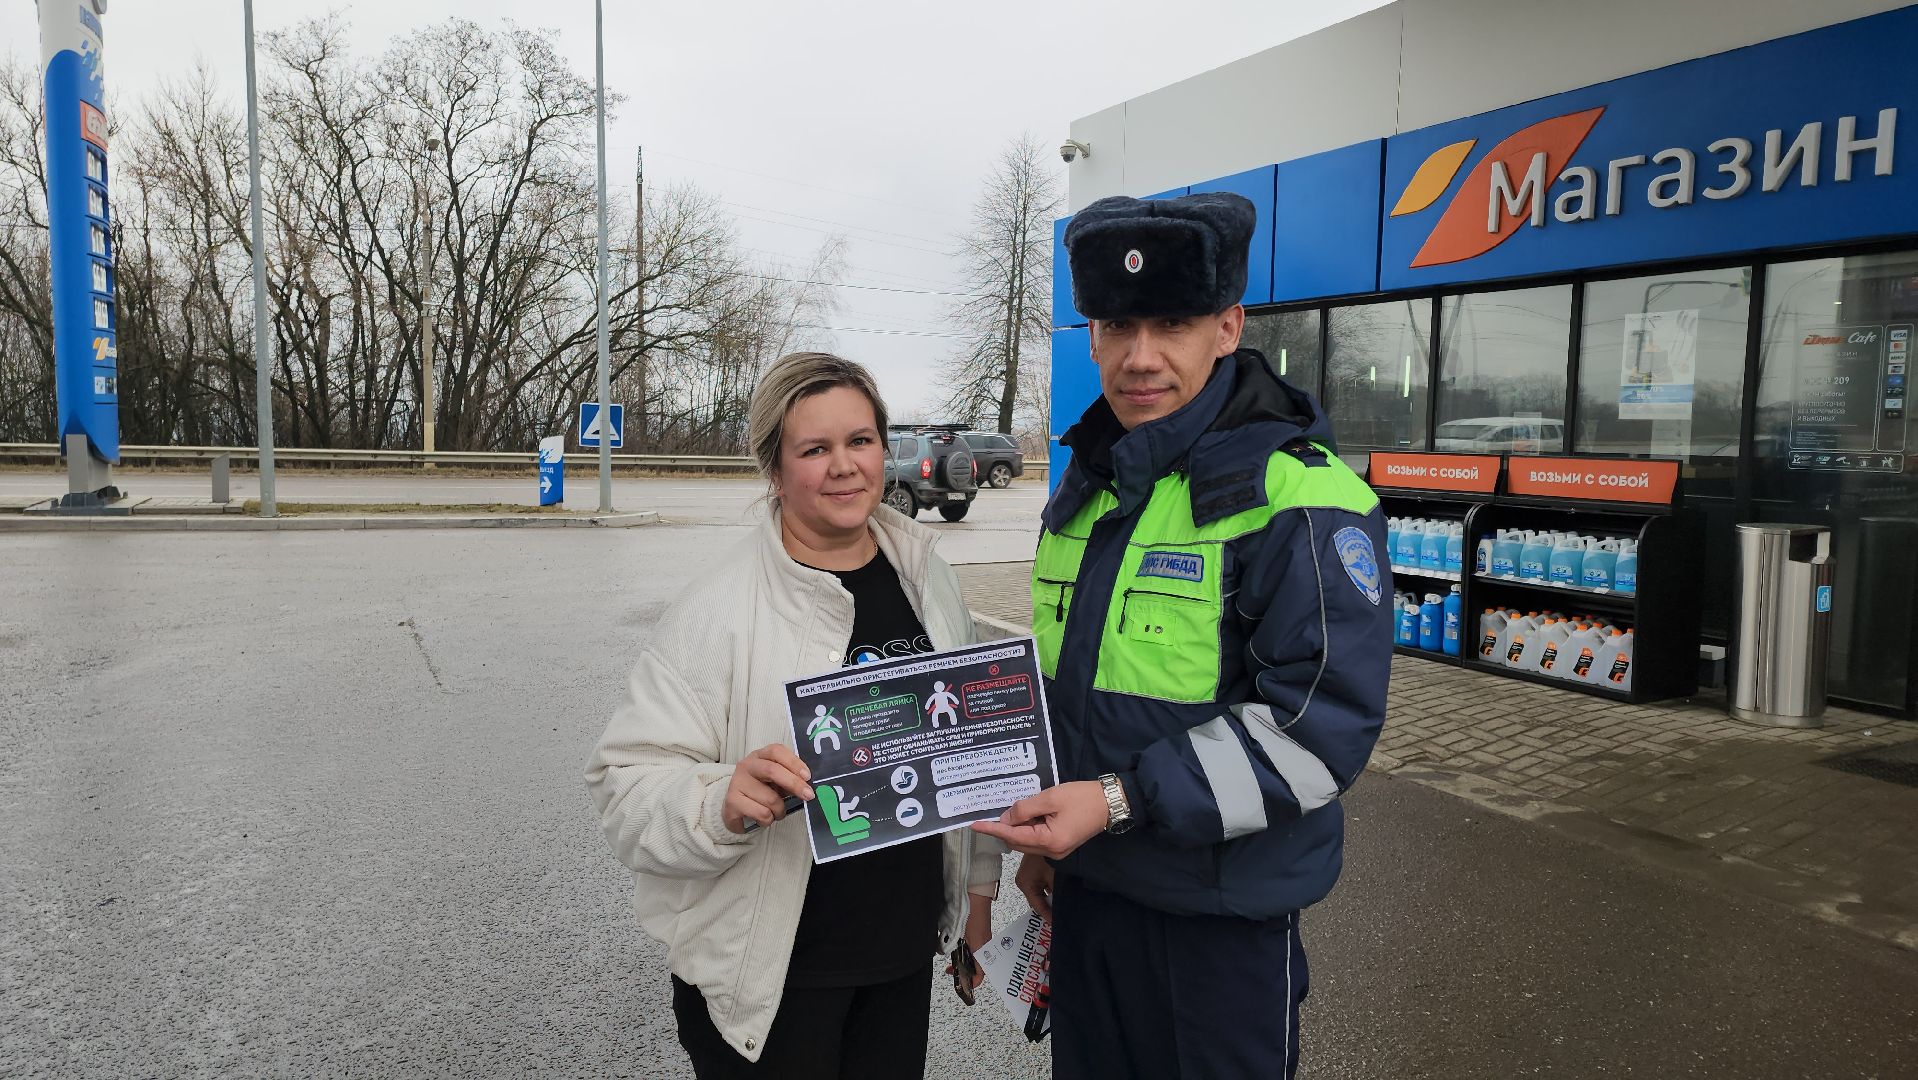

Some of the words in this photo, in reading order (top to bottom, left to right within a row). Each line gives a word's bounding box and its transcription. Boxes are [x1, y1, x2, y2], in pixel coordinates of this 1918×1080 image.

[1487, 107, 1898, 234] Магазин
[1847, 331, 1877, 345] Cafe
[1834, 376, 1850, 385] 209
[1387, 465, 1427, 477] ВОЗЬМИ
[1429, 467, 1438, 476] С
[1439, 465, 1479, 480] СОБОЙ
[1529, 471, 1581, 484] ВОЗЬМИ
[1585, 474, 1595, 484] С
[1598, 472, 1649, 488] СОБОЙ
[1160, 558, 1198, 575] ГИБДД
[799, 686, 816, 695] КАК
[817, 677, 862, 692] ПРАВИЛЬНО
[862, 664, 928, 681] ПРИСТЕГИВАТЬСЯ
[928, 659, 959, 669] РЕМНЕМ
[934, 758, 950, 766] ПРИ
[951, 750, 994, 763] ПЕРЕВОЗКЕ
[993, 745, 1018, 756] ДЕТЕЙ
[1006, 961, 1028, 998] ОДИН
[1018, 910, 1043, 962] ЩЕЛЧОК
[1019, 948, 1045, 1004] СПАСАЕТ
[1037, 920, 1053, 950] ЖИЗ
